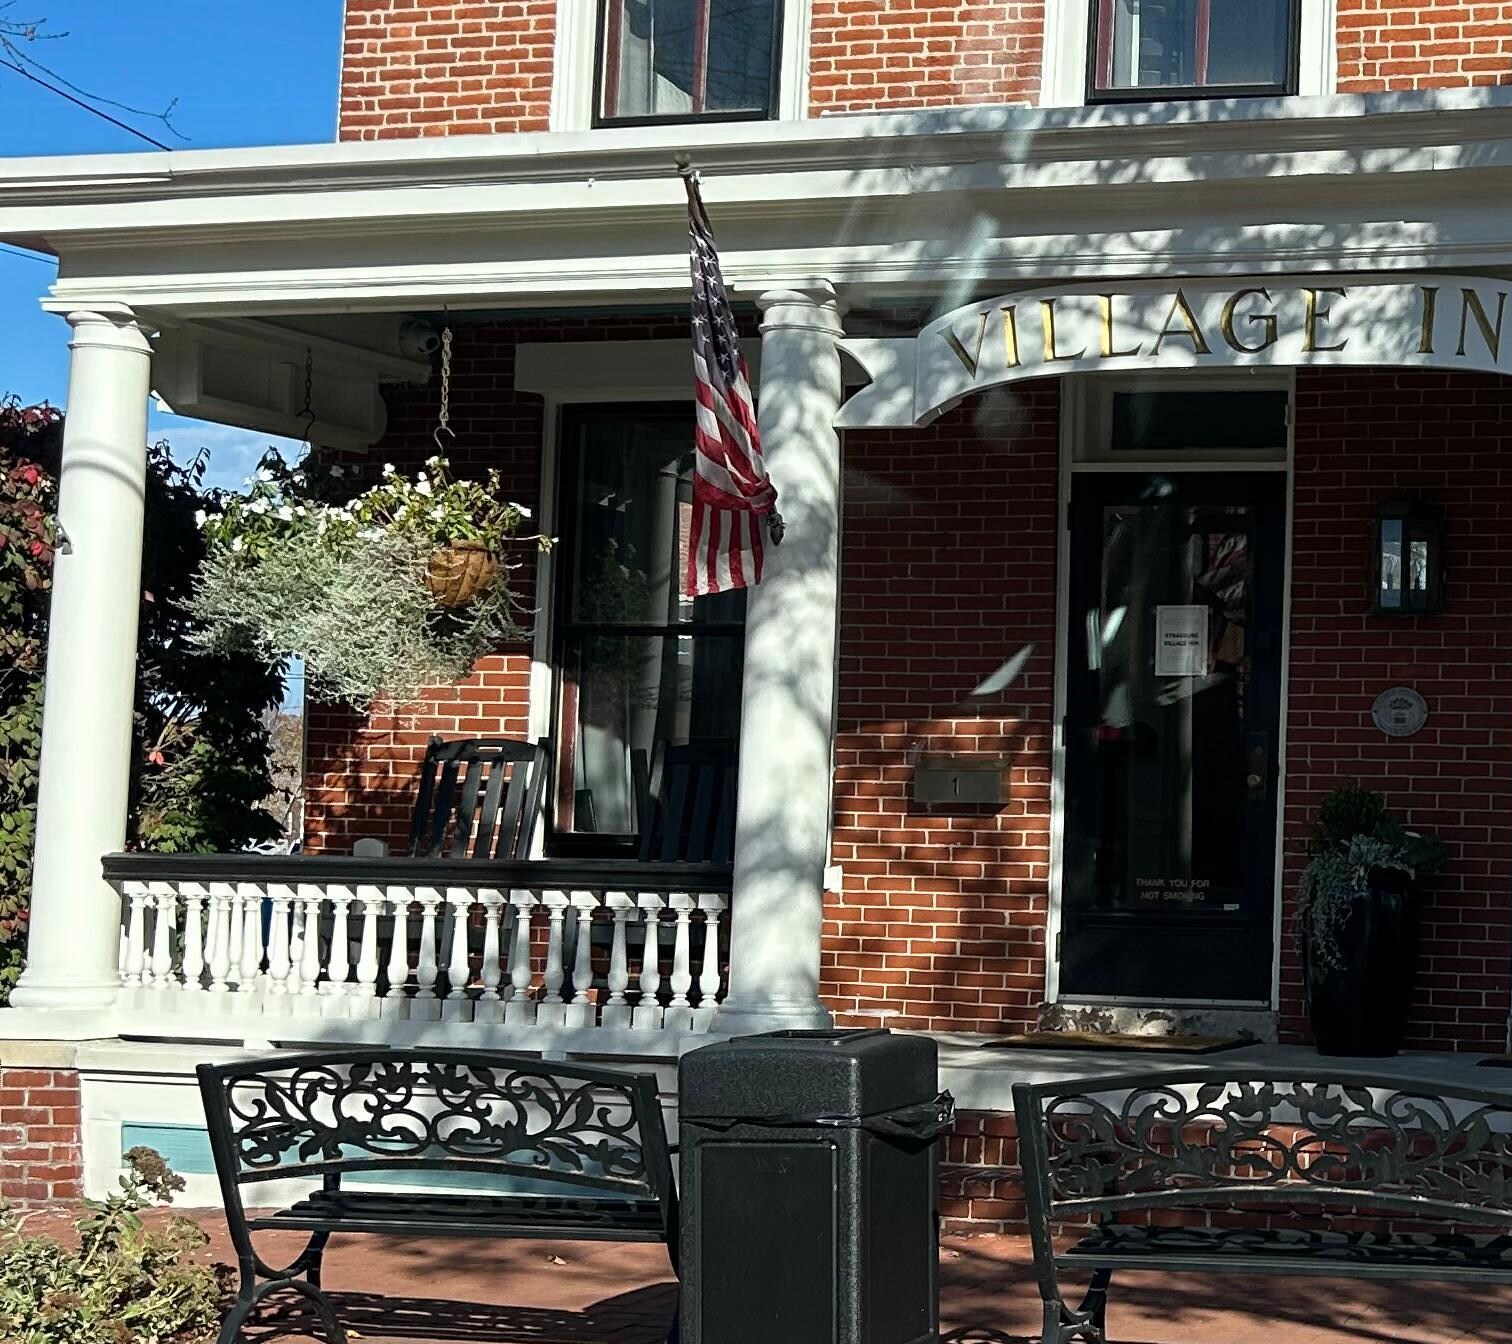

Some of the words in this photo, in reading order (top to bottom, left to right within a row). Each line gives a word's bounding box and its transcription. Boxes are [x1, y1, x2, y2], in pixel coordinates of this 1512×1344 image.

[936, 286, 1351, 381] VILLAGE
[951, 775, 959, 796] 1
[1136, 878, 1166, 887] THANK
[1169, 878, 1188, 888] YOU
[1191, 879, 1210, 888] FOR
[1140, 891, 1159, 900] NOT
[1163, 891, 1205, 901] SMOKING
